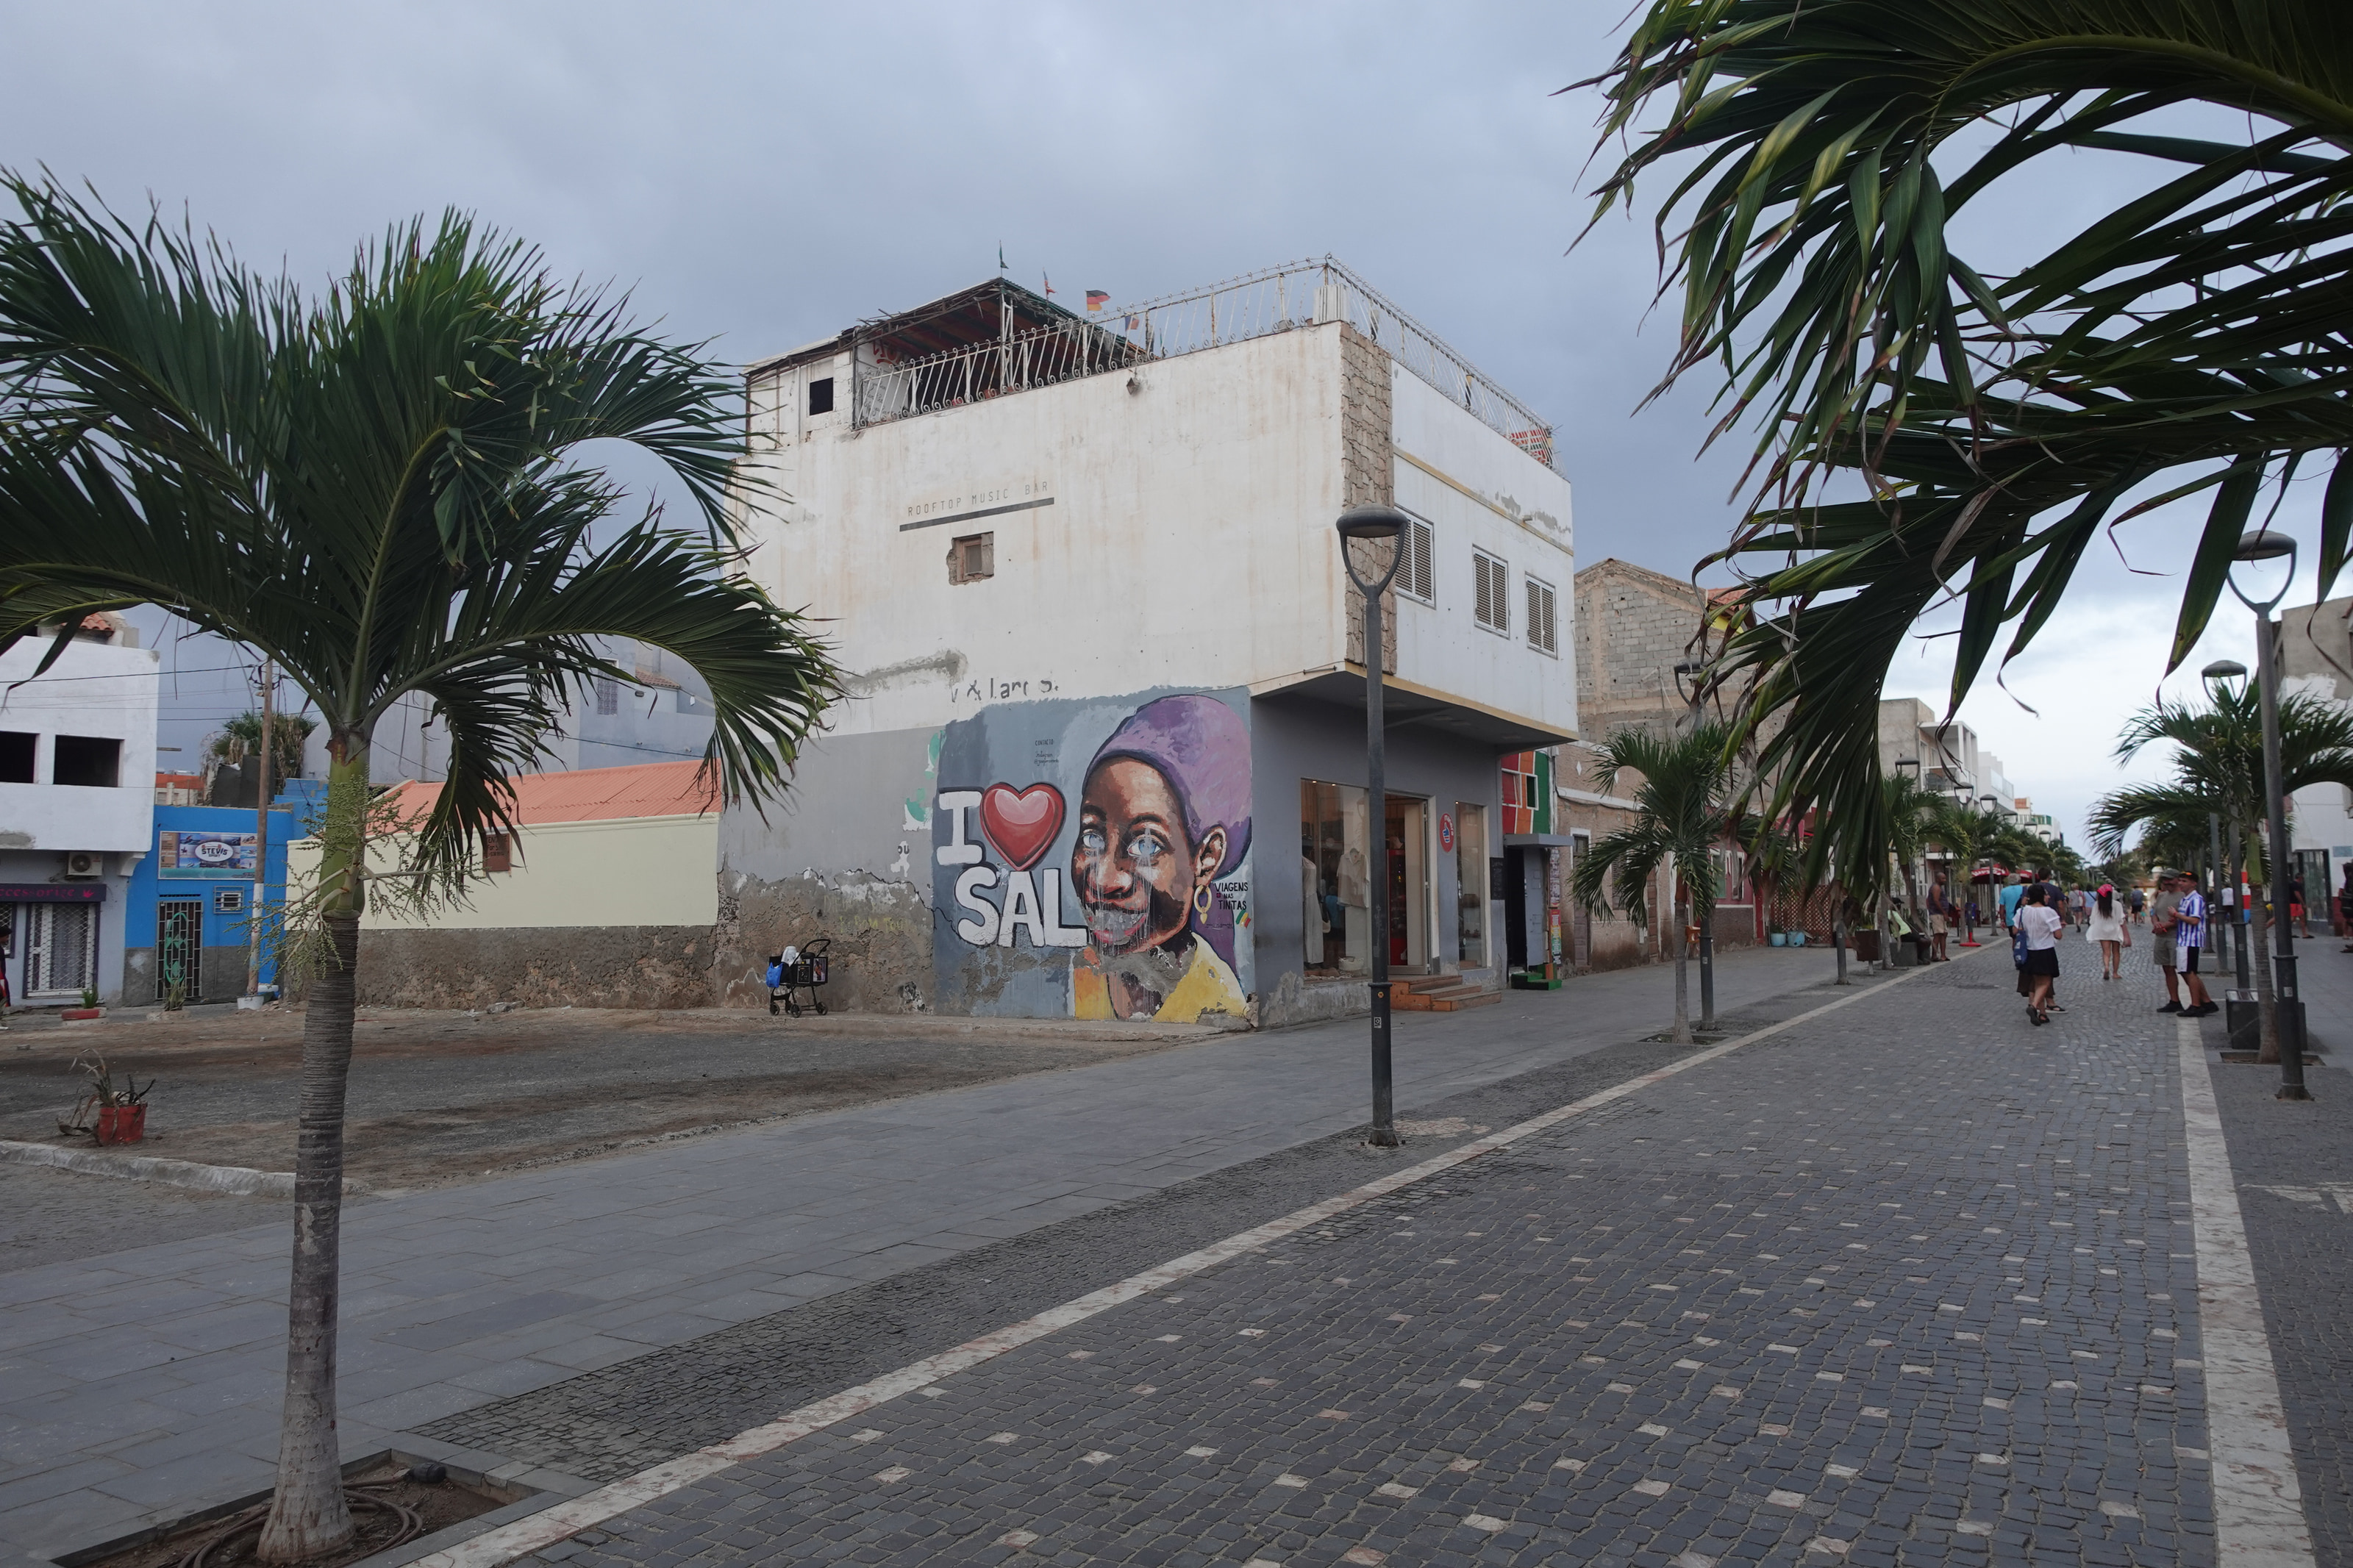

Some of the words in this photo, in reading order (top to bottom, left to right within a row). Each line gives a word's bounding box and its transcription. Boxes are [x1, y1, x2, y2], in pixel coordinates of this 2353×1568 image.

[908, 498, 961, 517] ROOFTOP
[971, 489, 1008, 505] MUSIC
[1025, 482, 1048, 495] BAR
[936, 789, 984, 865] I
[1213, 882, 1249, 892] VIAGENS
[954, 865, 1089, 948] SAL
[1218, 900, 1247, 910] TINTAS
